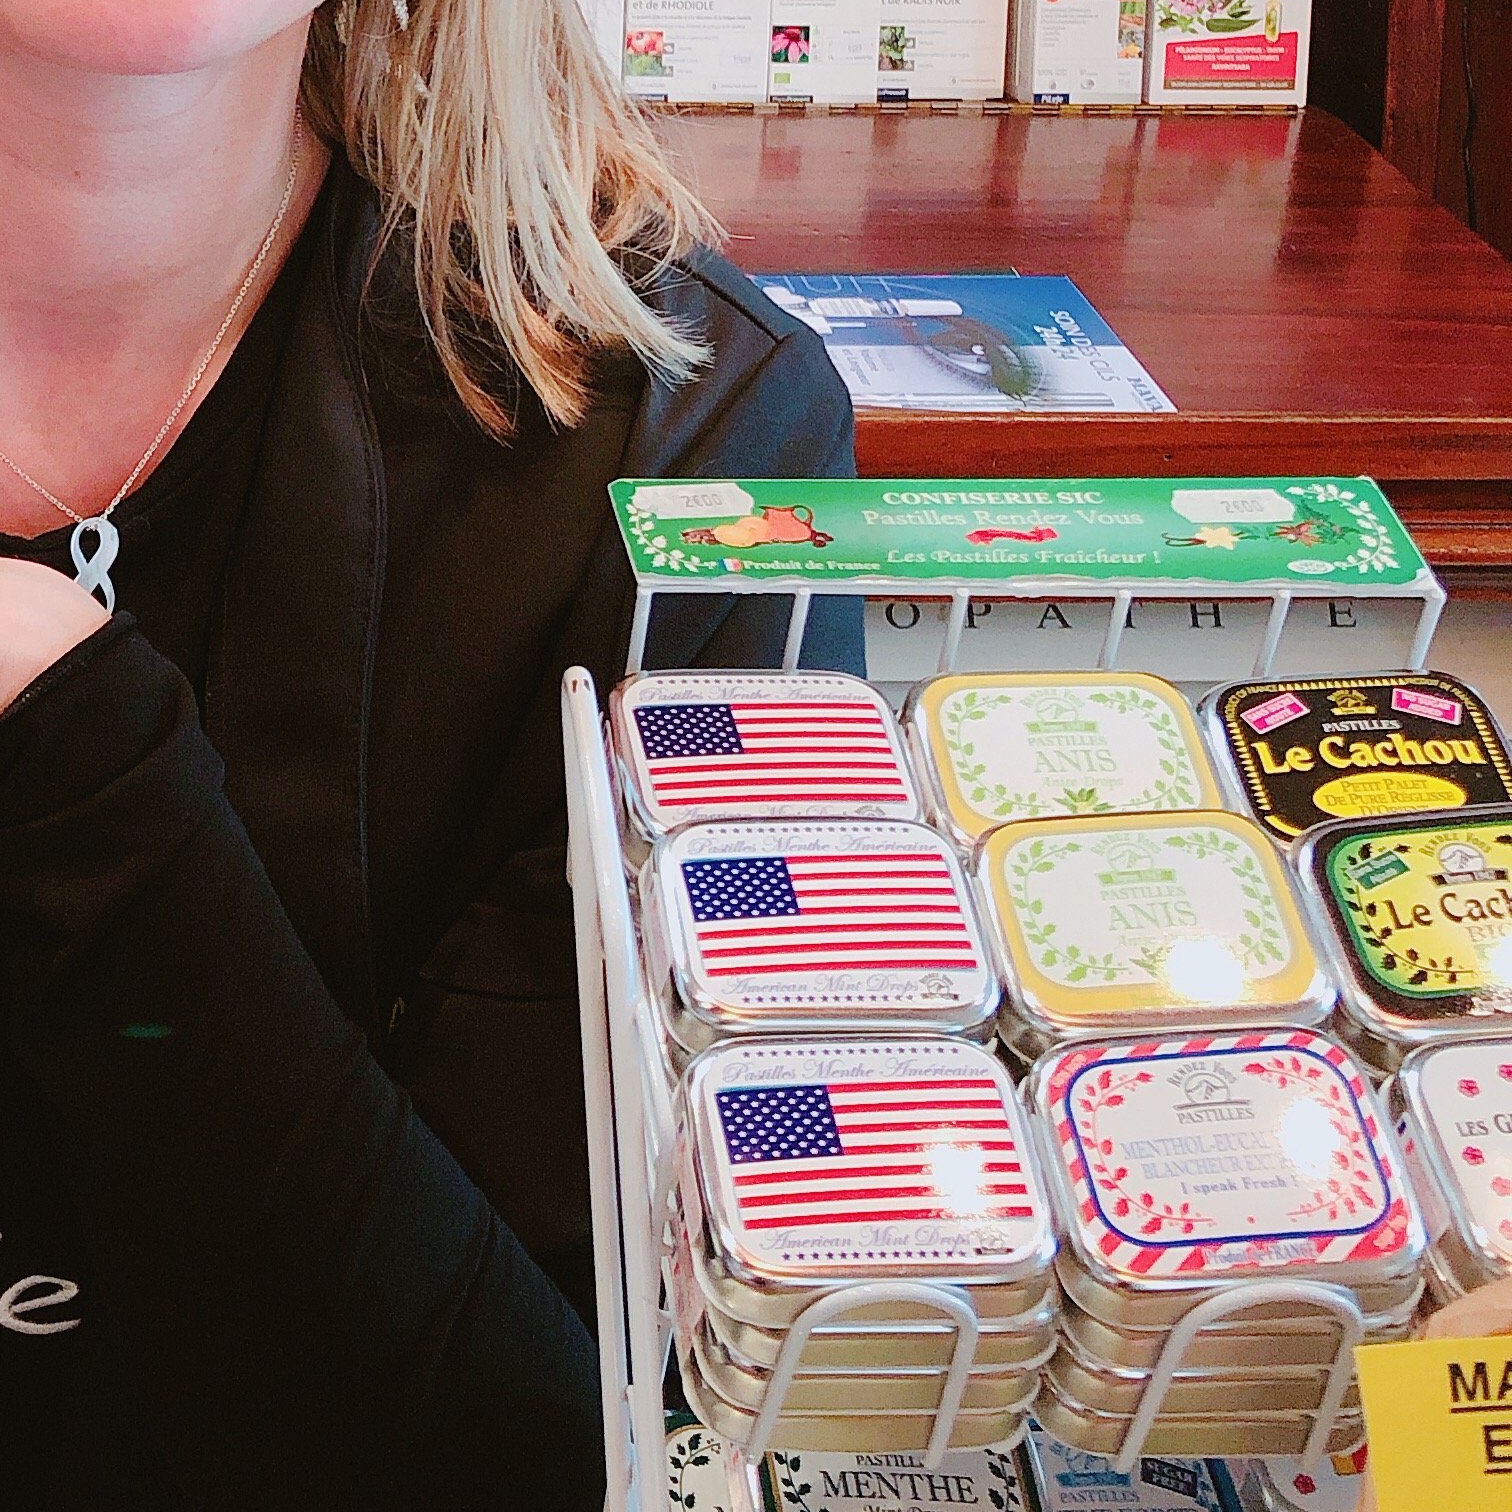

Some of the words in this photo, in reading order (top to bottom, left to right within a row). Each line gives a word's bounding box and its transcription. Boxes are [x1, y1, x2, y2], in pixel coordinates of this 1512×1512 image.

[645, 0, 659, 11] de
[661, 0, 715, 12] RHODIOLE
[881, 491, 1053, 506] CONFISERIE
[1057, 490, 1104, 506] SIC
[862, 511, 970, 527] Pastilles
[972, 509, 1072, 527] Rendez
[1074, 510, 1145, 526] Vous
[742, 560, 802, 570] Produit
[803, 560, 824, 570] de
[826, 560, 881, 571] France
[886, 549, 928, 564] Les
[931, 548, 1029, 567] Pastilles
[1033, 548, 1146, 566] Fraîcheur
[1321, 719, 1403, 734] PASTILLES
[1250, 741, 1316, 775] Le
[1318, 732, 1488, 769] Cachou
[1108, 901, 1198, 931] ANIS
[1382, 899, 1434, 930] Le
[723, 1061, 797, 1083] Pastilles
[803, 1060, 874, 1080] Menthe
[878, 1058, 989, 1078] Américaine
[1175, 1106, 1256, 1125] PASTILLES
[1455, 1121, 1489, 1138] LES
[1193, 1179, 1238, 1196] speak
[1245, 1174, 1287, 1192] Fresh
[759, 1228, 852, 1251] American
[858, 1226, 909, 1248] Mint
[819, 1470, 979, 1504] MENTHE
